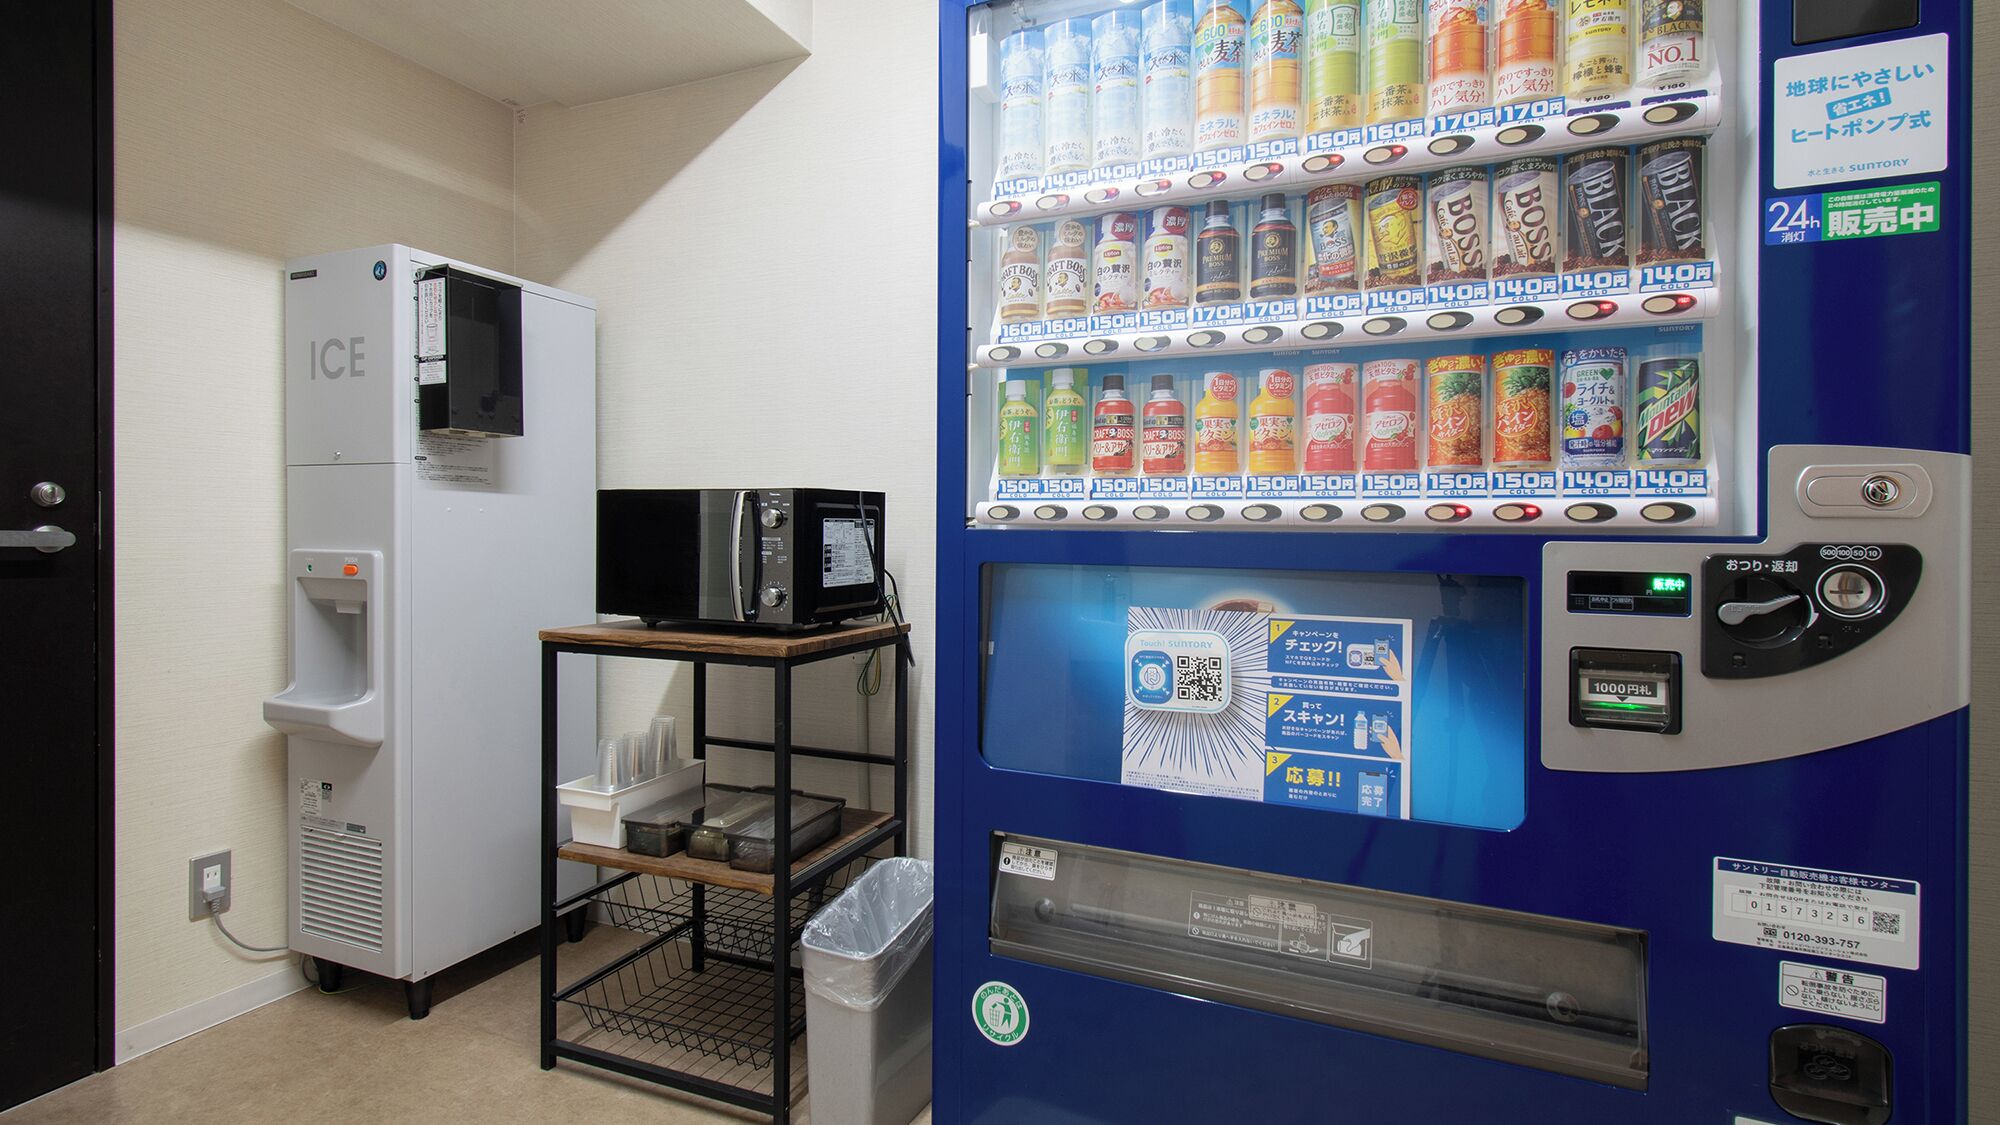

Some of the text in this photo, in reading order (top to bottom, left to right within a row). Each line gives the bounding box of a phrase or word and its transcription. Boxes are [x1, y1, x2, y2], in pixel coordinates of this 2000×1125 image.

[1657, 21, 1691, 35] BLACK
[1271, 29, 1303, 54] 麦茶
[1214, 39, 1245, 64] 麦茶
[1648, 37, 1700, 69] NO.1
[1786, 63, 1935, 97] 地球にやさしい
[1504, 99, 1563, 122] 170円
[1832, 92, 1885, 116] 省エネ!
[1254, 109, 1296, 124] ミネラル!
[1438, 110, 1493, 131] 170円
[1369, 121, 1423, 141] 160円
[1791, 110, 1931, 143] ヒートポンプ式
[1247, 139, 1297, 157] 150円
[1309, 130, 1361, 149] 160円
[1195, 147, 1241, 164] 150円
[1093, 165, 1136, 182] 140円
[1142, 157, 1188, 174] 140円
[1808, 158, 1910, 177] 水と生きる SUNTORY
[997, 178, 1037, 194] 140円
[1046, 171, 1087, 188] 140円
[1582, 168, 1626, 257] BLACK
[1657, 161, 1701, 250] BLACK
[1515, 185, 1552, 260] BOSS
[1828, 203, 1934, 238] 販売中
[1447, 194, 1483, 267] BOSS
[1781, 231, 1805, 243] 消灯
[1564, 271, 1627, 291] 140円
[1644, 264, 1711, 284] 140円
[1430, 284, 1486, 302] 140円
[1497, 278, 1557, 297] 140円
[1308, 295, 1359, 311] 140円
[1370, 289, 1424, 307] 140円
[1141, 309, 1186, 325] 150円
[1194, 304, 1241, 321] 170円
[1246, 300, 1296, 317] 170円
[1002, 323, 1041, 337] 160円
[1045, 319, 1087, 335] 160円
[1092, 314, 1135, 329] 150円
[310, 336, 365, 381] ICE
[1565, 348, 1627, 364] 汗をかいたら
[1270, 374, 1291, 383] 1日分の
[1577, 369, 1599, 377] GREEN
[1577, 382, 1615, 396] ライチ&
[1571, 412, 1585, 426] 塩
[1000, 479, 1039, 493] 150円
[1041, 479, 1083, 493] 150円
[1094, 479, 1137, 492] 150円
[1141, 478, 1187, 491] 150円
[1194, 477, 1241, 491] 150円
[1248, 477, 1298, 491] 150円
[1302, 475, 1355, 490] 150円
[1364, 474, 1418, 490] 150円
[1429, 474, 1486, 489] 150円
[1495, 473, 1554, 488] 150円
[1565, 471, 1629, 488] 140円
[1637, 470, 1705, 487] 140円
[1854, 549, 1863, 557] 50
[1726, 560, 1798, 574] おつり・返却
[1653, 578, 1685, 591] 販売中
[1292, 630, 1339, 638] キャンペーンを
[1168, 639, 1213, 649] SUNTORY
[1285, 639, 1342, 653] チェック!
[1594, 682, 1651, 695] 1000円札
[1284, 709, 1345, 726] スキャン!
[1286, 767, 1341, 787] 応募!!
[1361, 784, 1384, 795] 応募
[1361, 796, 1384, 808] 完了
[1732, 862, 1900, 890] サントリー自動販売機お客様センター
[1783, 931, 1861, 950] 0120-393-757
[1826, 970, 1854, 986] 警告
[983, 1023, 1019, 1042] リサイクル
